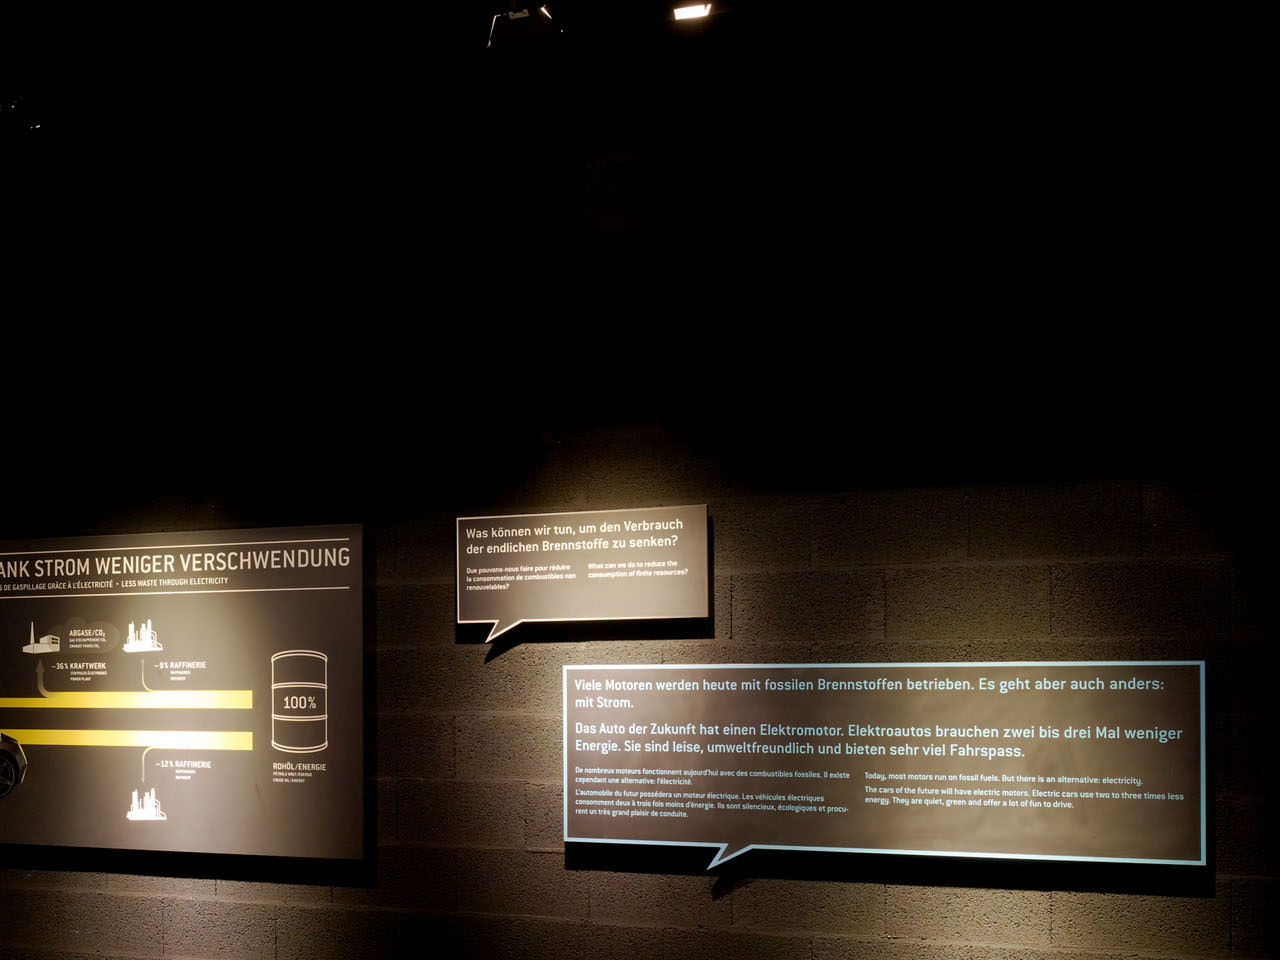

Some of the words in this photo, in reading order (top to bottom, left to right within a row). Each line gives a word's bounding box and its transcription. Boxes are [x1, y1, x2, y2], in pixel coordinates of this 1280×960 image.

[466, 528, 488, 538] Was
[491, 527, 531, 537] können
[534, 524, 551, 535] wir
[553, 525, 576, 535] tun,
[578, 525, 596, 534] um
[599, 521, 621, 533] den
[623, 518, 683, 531] Verbrauch
[466, 543, 484, 554] der
[486, 541, 539, 554] endlichen
[542, 537, 609, 551] Brennstoffe
[612, 539, 626, 548] zu
[629, 534, 678, 548] senken?
[34, 558, 89, 577] STROM
[95, 554, 175, 575] WENIGER
[179, 547, 350, 572] VERSCHWENDUNG
[12, 583, 46, 591] GASPILLAGE
[47, 581, 66, 589] GRÂCE
[121, 579, 136, 587] LESS
[137, 579, 157, 587] WASTE
[158, 578, 188, 586] THROUGH
[189, 577, 228, 585] ELECTRICITY
[70, 662, 107, 670] KRAFTWERK
[170, 661, 207, 670] RAFFINERIE
[574, 679, 602, 691] Viele
[605, 679, 652, 691] Motoren
[655, 679, 699, 691] werden
[702, 679, 737, 690] heute
[741, 678, 761, 690] mit
[764, 678, 813, 690] fossilen
[818, 678, 902, 690] Brennstoffen
[906, 678, 974, 690] betrieben.
[979, 678, 995, 690] Es
[999, 677, 1030, 694] geht
[1034, 677, 1066, 690] aber
[1070, 677, 1104, 690] auch
[1109, 677, 1164, 690] anders:
[283, 696, 317, 710] 100%
[575, 696, 594, 708] mit
[596, 696, 634, 708] Strom.
[575, 722, 596, 734] Das
[598, 722, 625, 734] Auto
[628, 722, 648, 734] der
[650, 722, 696, 735] Zukunft
[699, 723, 719, 735] hat
[723, 723, 756, 735] einen
[760, 723, 844, 736] Elektromotor.
[848, 724, 931, 737] Elektroautos
[935, 724, 999, 738] brauchen
[1003, 725, 1034, 738] zwei
[1039, 725, 1060, 738] bis
[1064, 726, 1090, 738] drei
[1096, 726, 1120, 739] Mal
[1124, 726, 1183, 743] weniger
[575, 739, 621, 755] Energie.
[624, 739, 641, 752] Sie
[644, 740, 669, 752] sind
[672, 740, 704, 754] leise,
[707, 741, 814, 754] umweltfreundlich
[818, 742, 841, 754] und
[845, 742, 886, 755] bieten
[889, 743, 919, 755] sehr
[922, 743, 945, 756] viel
[950, 743, 1024, 760] Fahrspass.
[175, 760, 212, 769] RAFFINERIE
[272, 762, 327, 771] ROHÖL/ENERGIE
[864, 771, 887, 781] Today,
[958, 773, 978, 781] fossil
[980, 773, 1000, 782] fuels.
[1001, 774, 1015, 782] But
[1057, 775, 1100, 783] alternative:
[1102, 776, 1142, 787] electricity.
[865, 785, 877, 793] The
[895, 786, 903, 794] of
[917, 786, 939, 795] future
[940, 787, 953, 795] will
[954, 787, 972, 795] have
[973, 788, 1000, 796] electric
[1031, 789, 1060, 797] Electric
[1095, 791, 1110, 799] two
[1121, 791, 1142, 799] three
[1143, 791, 1166, 800] times
[1167, 792, 1184, 800] less
